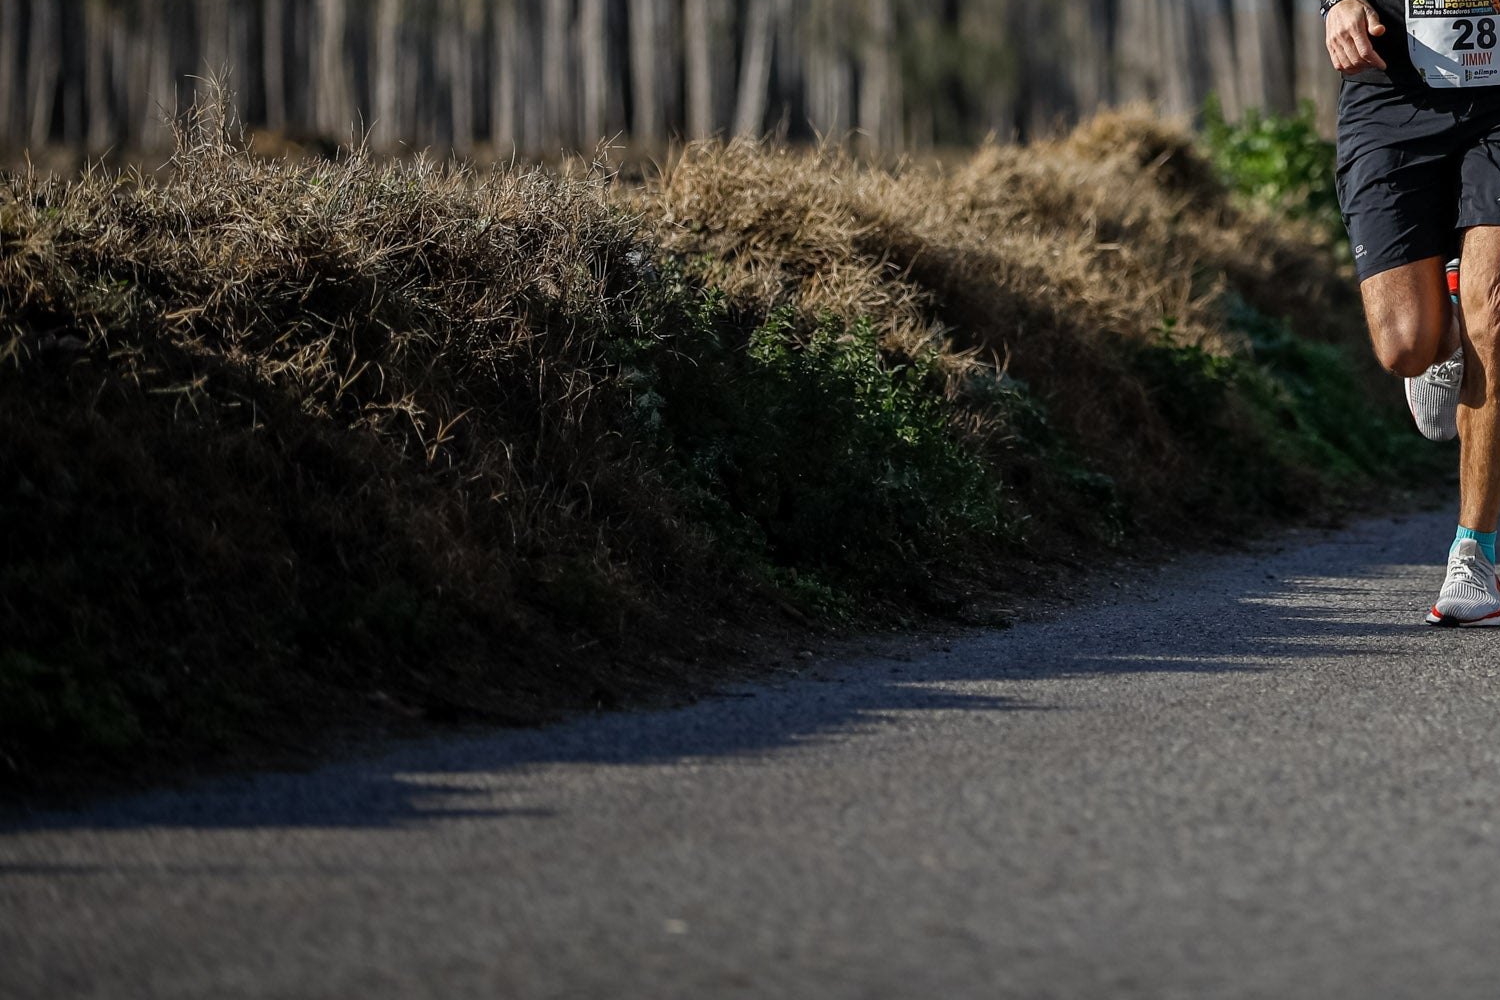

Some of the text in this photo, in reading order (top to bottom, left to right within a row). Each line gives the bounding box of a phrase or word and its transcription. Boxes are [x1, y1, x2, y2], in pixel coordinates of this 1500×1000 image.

[1444, 1, 1490, 9] POPULAR
[1452, 17, 1497, 51] 28
[1461, 52, 1493, 67] JIMMY
